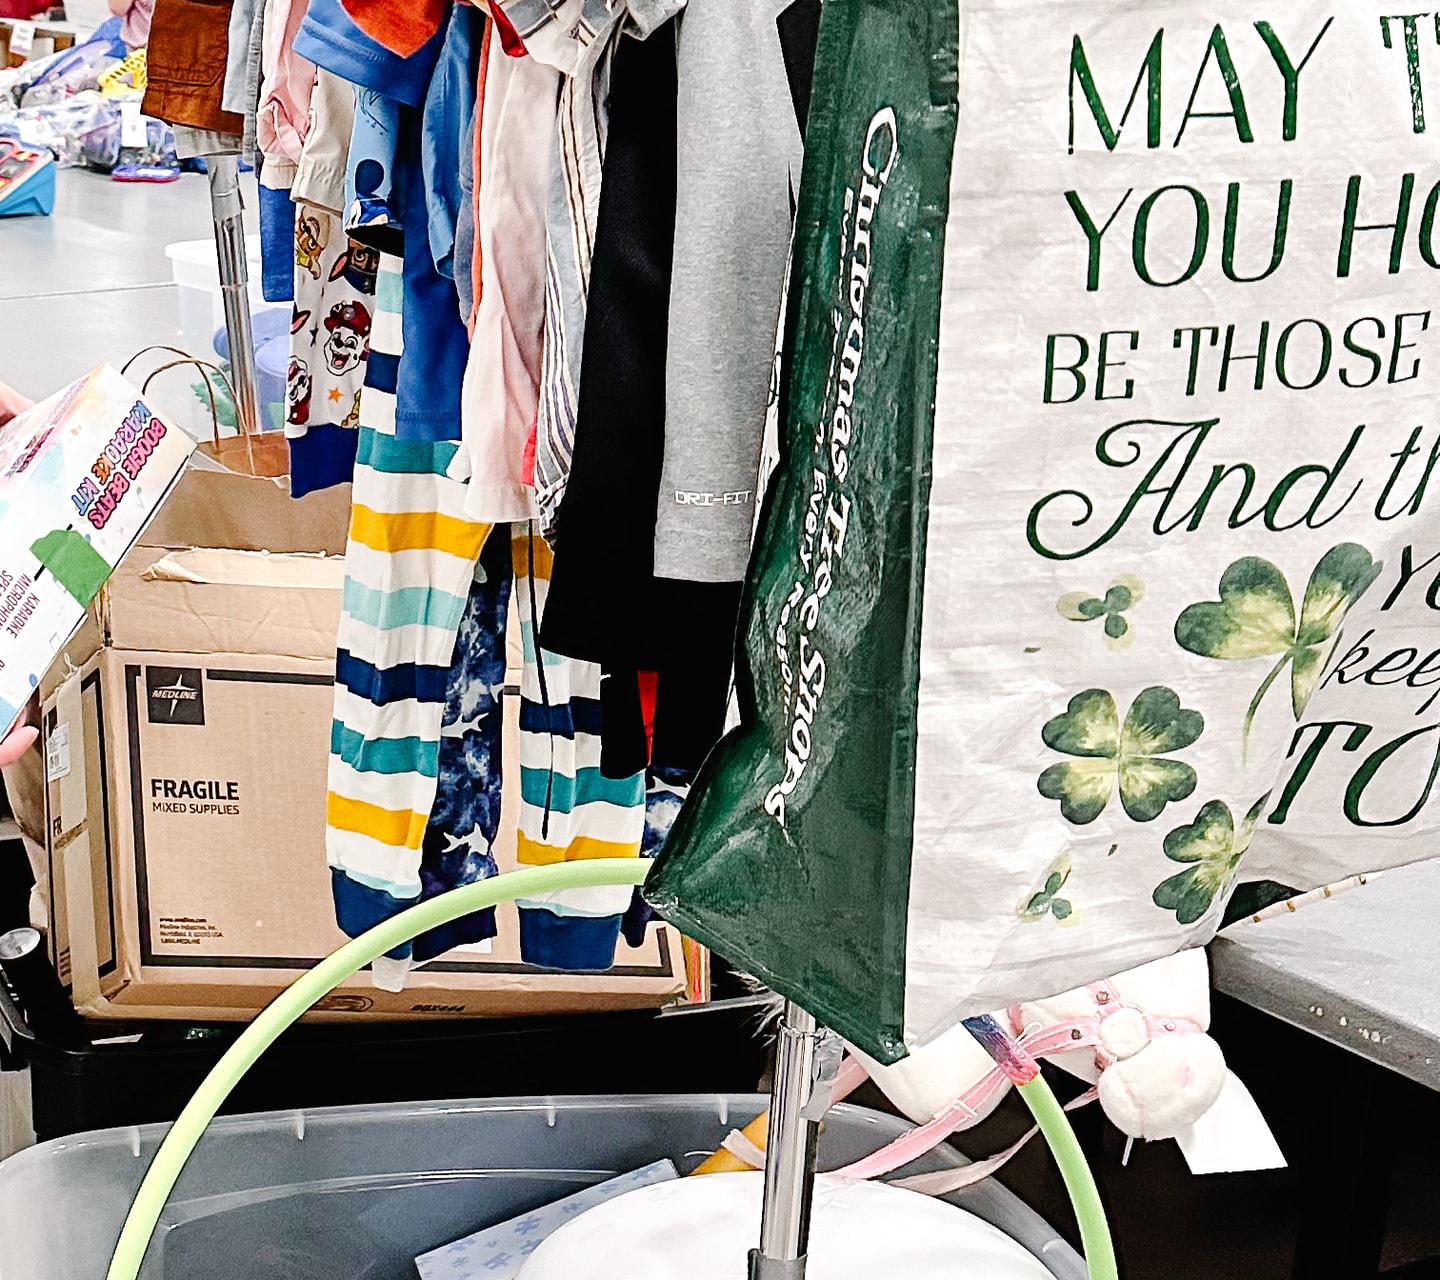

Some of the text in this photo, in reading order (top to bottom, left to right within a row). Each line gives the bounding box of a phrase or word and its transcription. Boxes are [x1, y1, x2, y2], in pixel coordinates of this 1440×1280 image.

[1067, 15, 1334, 155] MAY
[1064, 173, 1440, 292] YOU H
[1043, 311, 1431, 404] BE THOSE
[71, 400, 152, 516] KARAOKE KIT
[88, 417, 167, 529] BOOGIE BEATS
[674, 490, 752, 507] DRI-FIT
[1026, 417, 1366, 560] And
[799, 468, 827, 573] Every
[800, 490, 851, 632] Tree
[6, 592, 40, 639] KARAOKE
[151, 689, 199, 700] MEDLINE
[151, 778, 240, 800] FRAGILE
[152, 802, 240, 815] MIXED SUPPLIES
